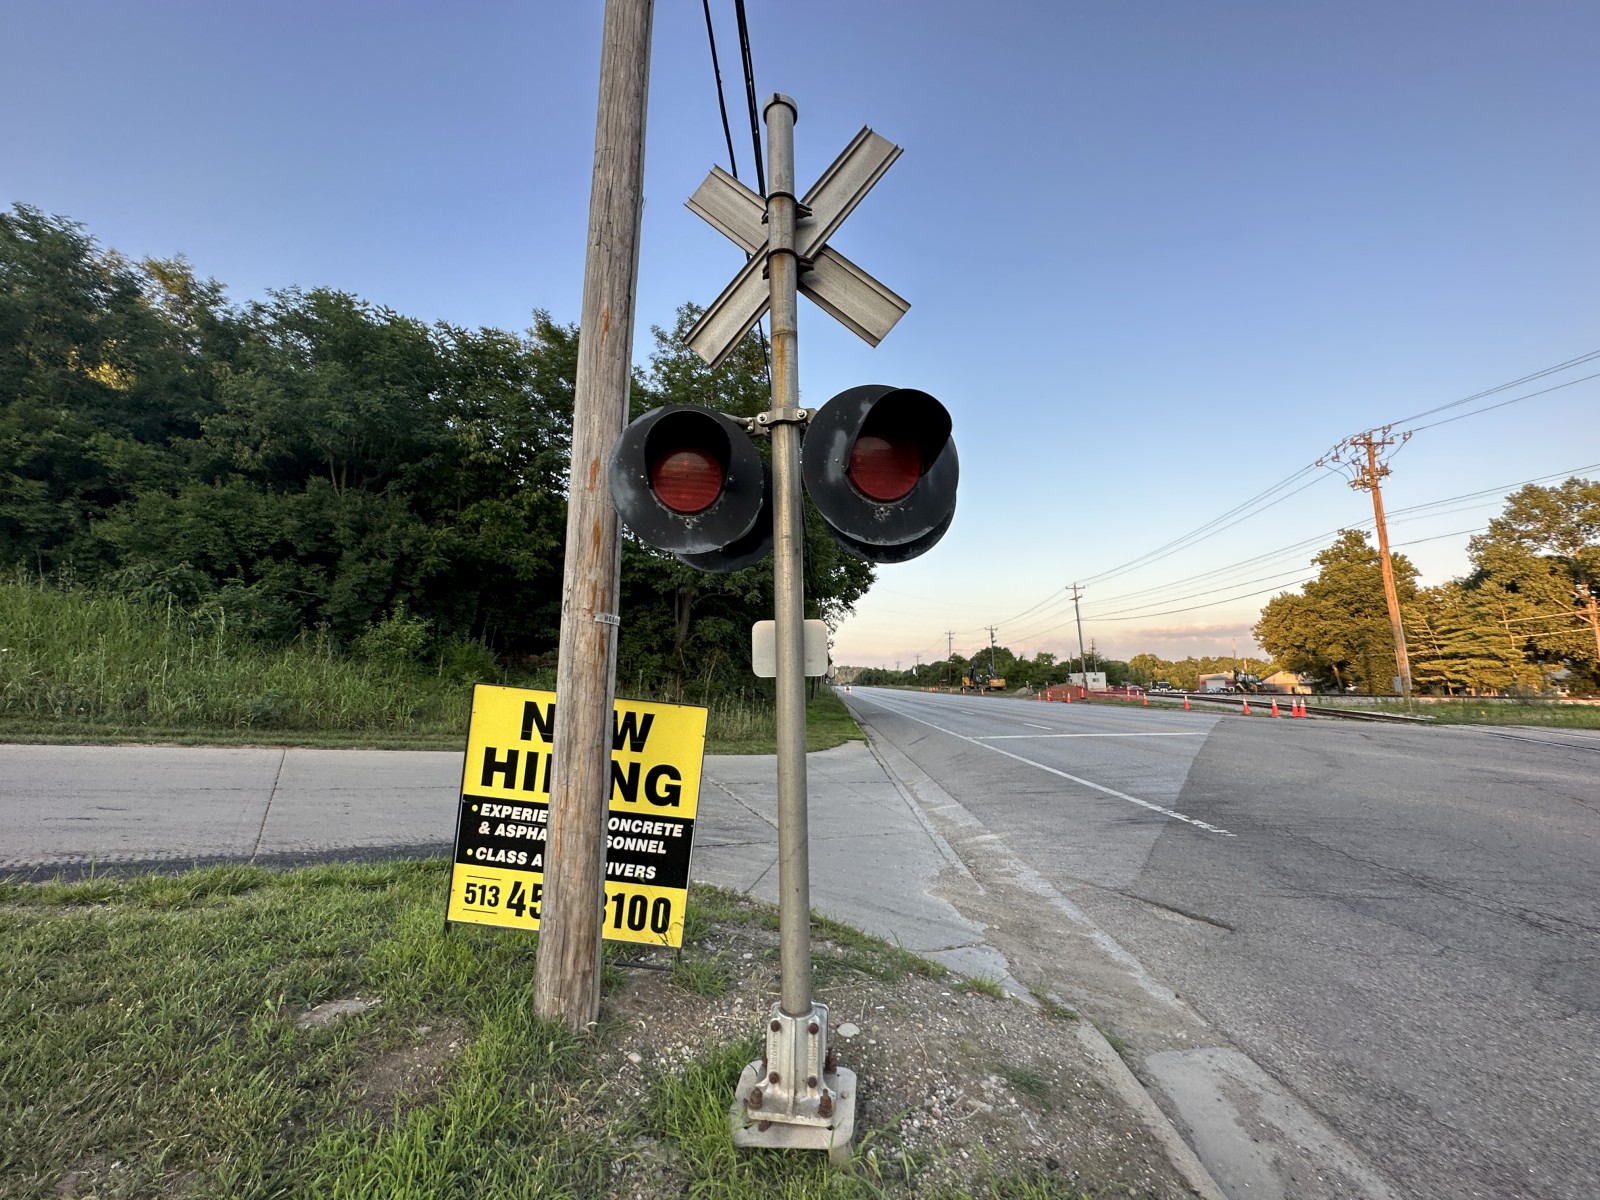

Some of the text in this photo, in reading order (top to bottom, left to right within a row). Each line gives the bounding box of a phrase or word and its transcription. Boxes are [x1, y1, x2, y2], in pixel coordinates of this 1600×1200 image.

[520, 700, 655, 753] NW
[481, 746, 681, 807] HING
[478, 821, 667, 854] & ASPHA SONNEL
[480, 803, 684, 838] EXPERIE ONCRETE
[475, 847, 657, 880] CLASS A IVERS
[464, 882, 500, 907] 513
[506, 881, 542, 919] 45
